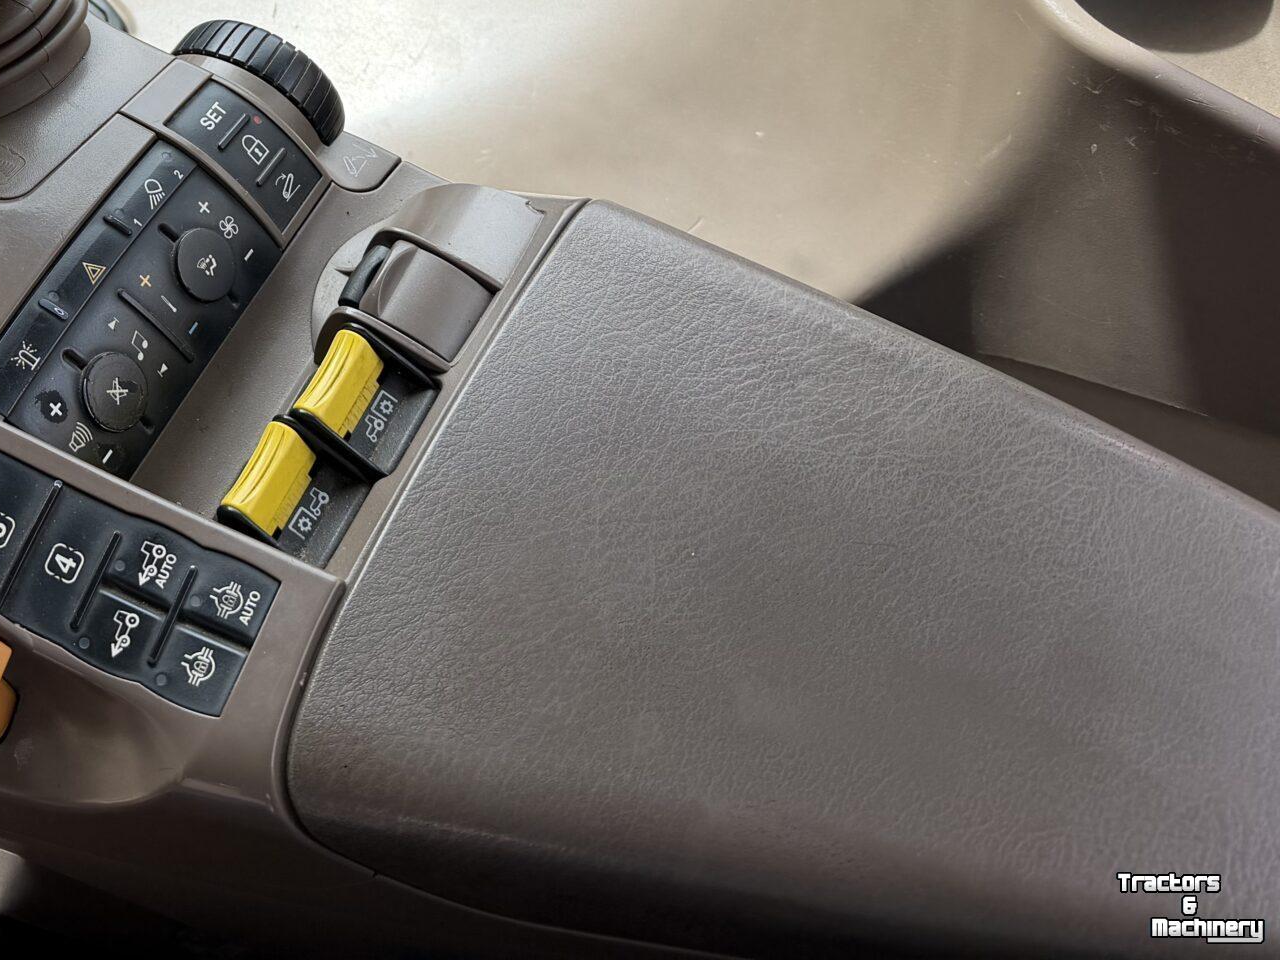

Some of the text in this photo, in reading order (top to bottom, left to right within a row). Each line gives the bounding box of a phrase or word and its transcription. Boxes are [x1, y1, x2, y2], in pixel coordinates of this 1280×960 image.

[199, 101, 228, 131] SET
[173, 169, 185, 180] 2
[52, 554, 78, 573] 4
[156, 554, 177, 589] AUTO
[240, 591, 262, 625] AUTO
